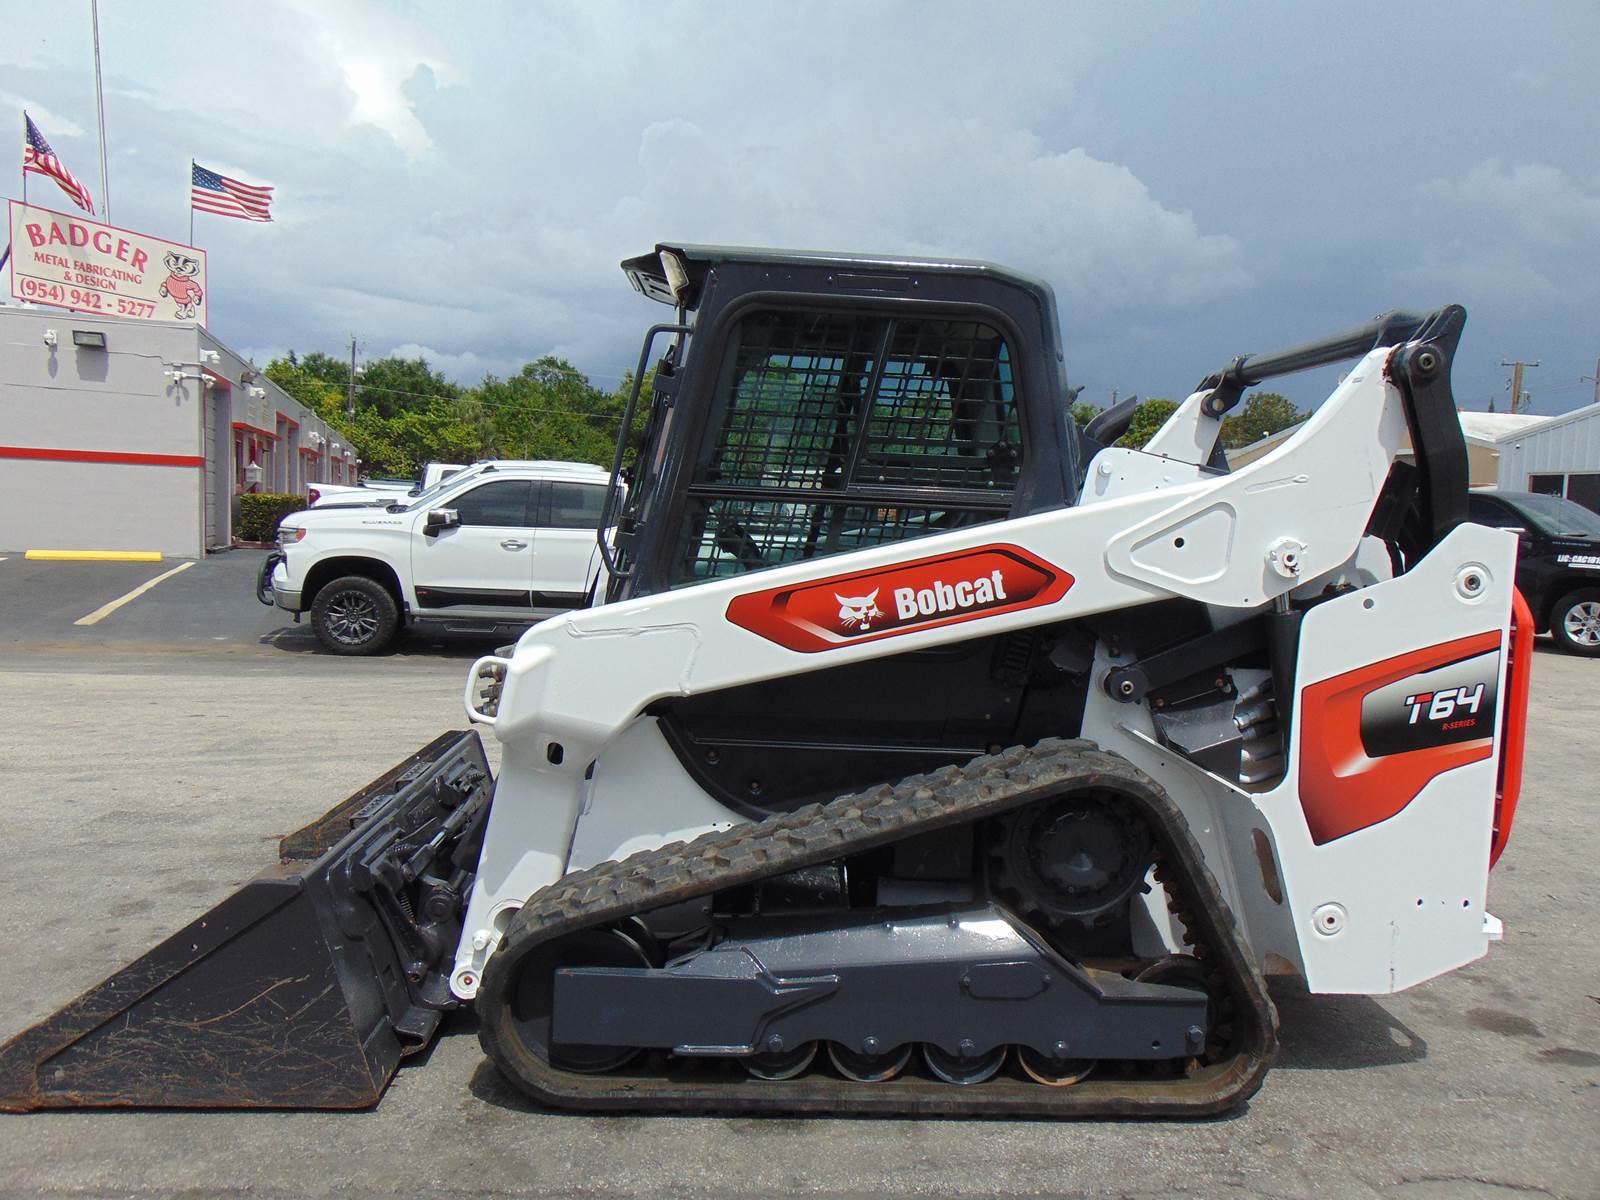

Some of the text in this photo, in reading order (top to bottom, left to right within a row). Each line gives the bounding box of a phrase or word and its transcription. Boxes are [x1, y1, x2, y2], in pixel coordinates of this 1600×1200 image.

[26, 222, 148, 273] BADGER
[34, 251, 142, 284] METAL FABRICATING
[20, 278, 65, 303] (954)
[70, 289, 102, 309] 942
[117, 299, 156, 318] 5277
[64, 271, 116, 290] & DESIGN
[894, 569, 1007, 620] Bobcat
[1405, 683, 1485, 725] T64
[1441, 719, 1477, 731] R-SERIES
